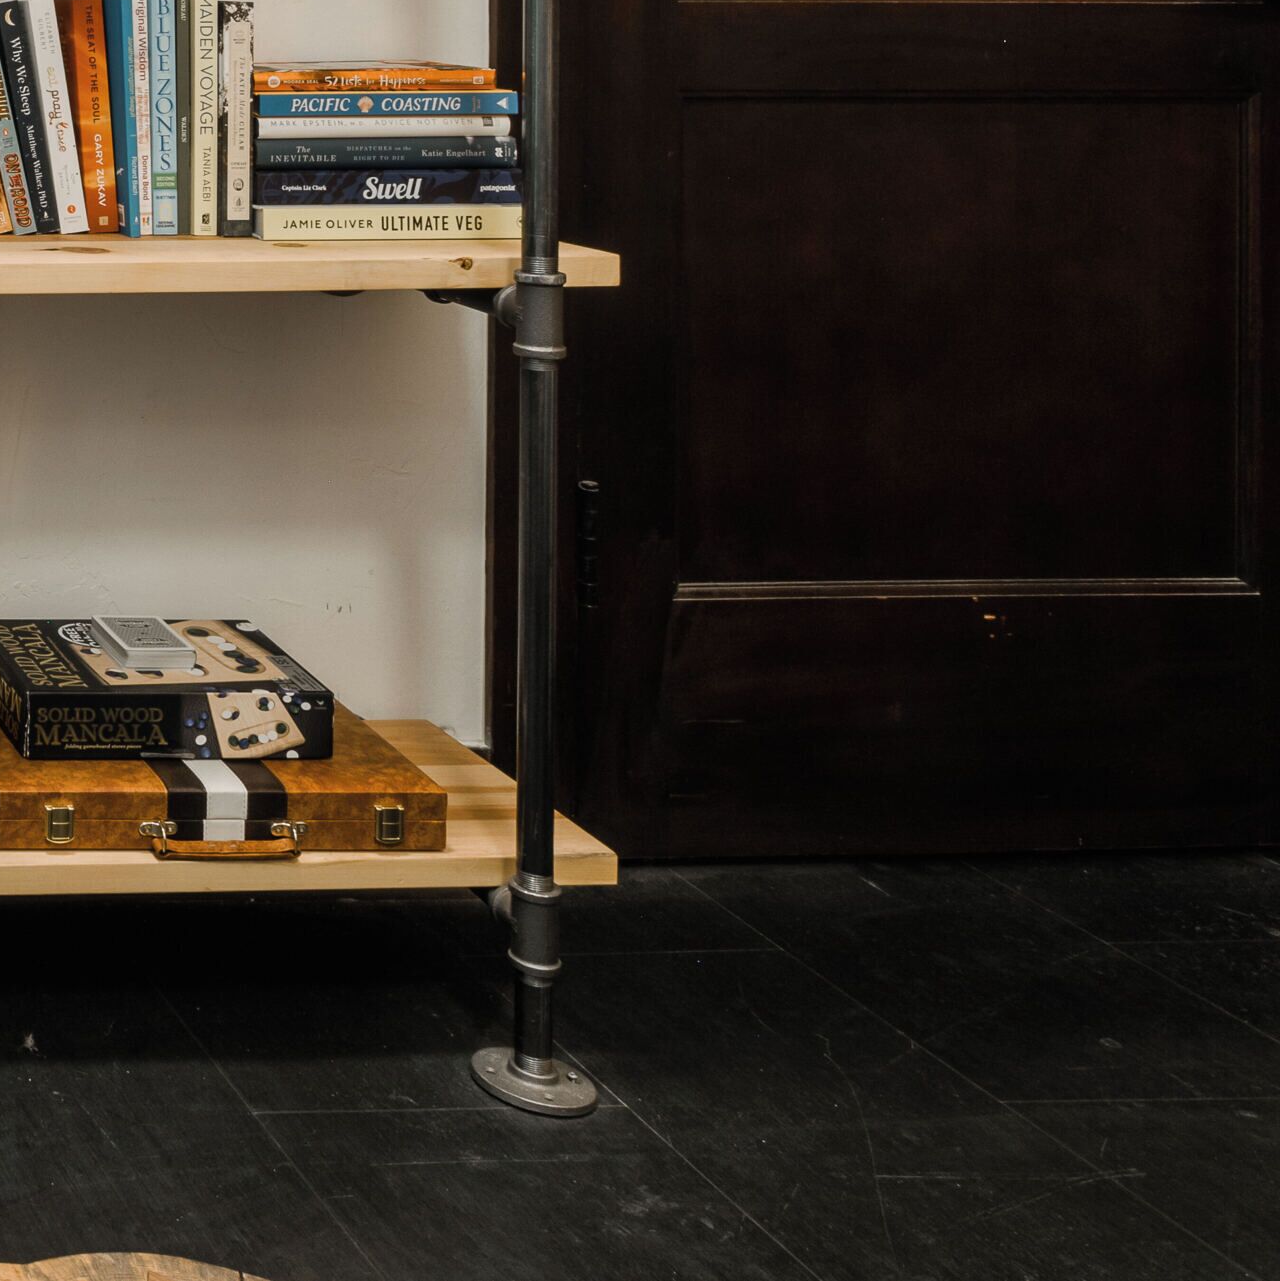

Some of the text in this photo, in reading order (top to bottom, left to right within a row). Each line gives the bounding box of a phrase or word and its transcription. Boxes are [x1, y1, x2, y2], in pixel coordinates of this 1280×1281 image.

[86, 5, 101, 124] THE SEAT OF THE SOUL
[138, 36, 148, 81] Wisdom
[9, 37, 31, 116] Why We Sleep
[199, 65, 215, 135] VOYAGE
[291, 96, 461, 112] PACIFIC COASTING
[271, 153, 337, 162] INEVITABLE
[296, 145, 311, 154] The
[421, 148, 486, 159] Katie Engelhart
[94, 133, 107, 207] GARY ZUKAV
[202, 147, 212, 201] TANIA AEBI
[362, 176, 423, 200] Swell
[479, 184, 516, 194] patagonia
[282, 219, 374, 229] JAMIE OLIVER
[381, 215, 483, 231] ULTIMATE VEG
[13, 623, 88, 688] MANCALA
[37, 707, 164, 724] SOLID WOOD
[34, 723, 169, 746] MANCALA
